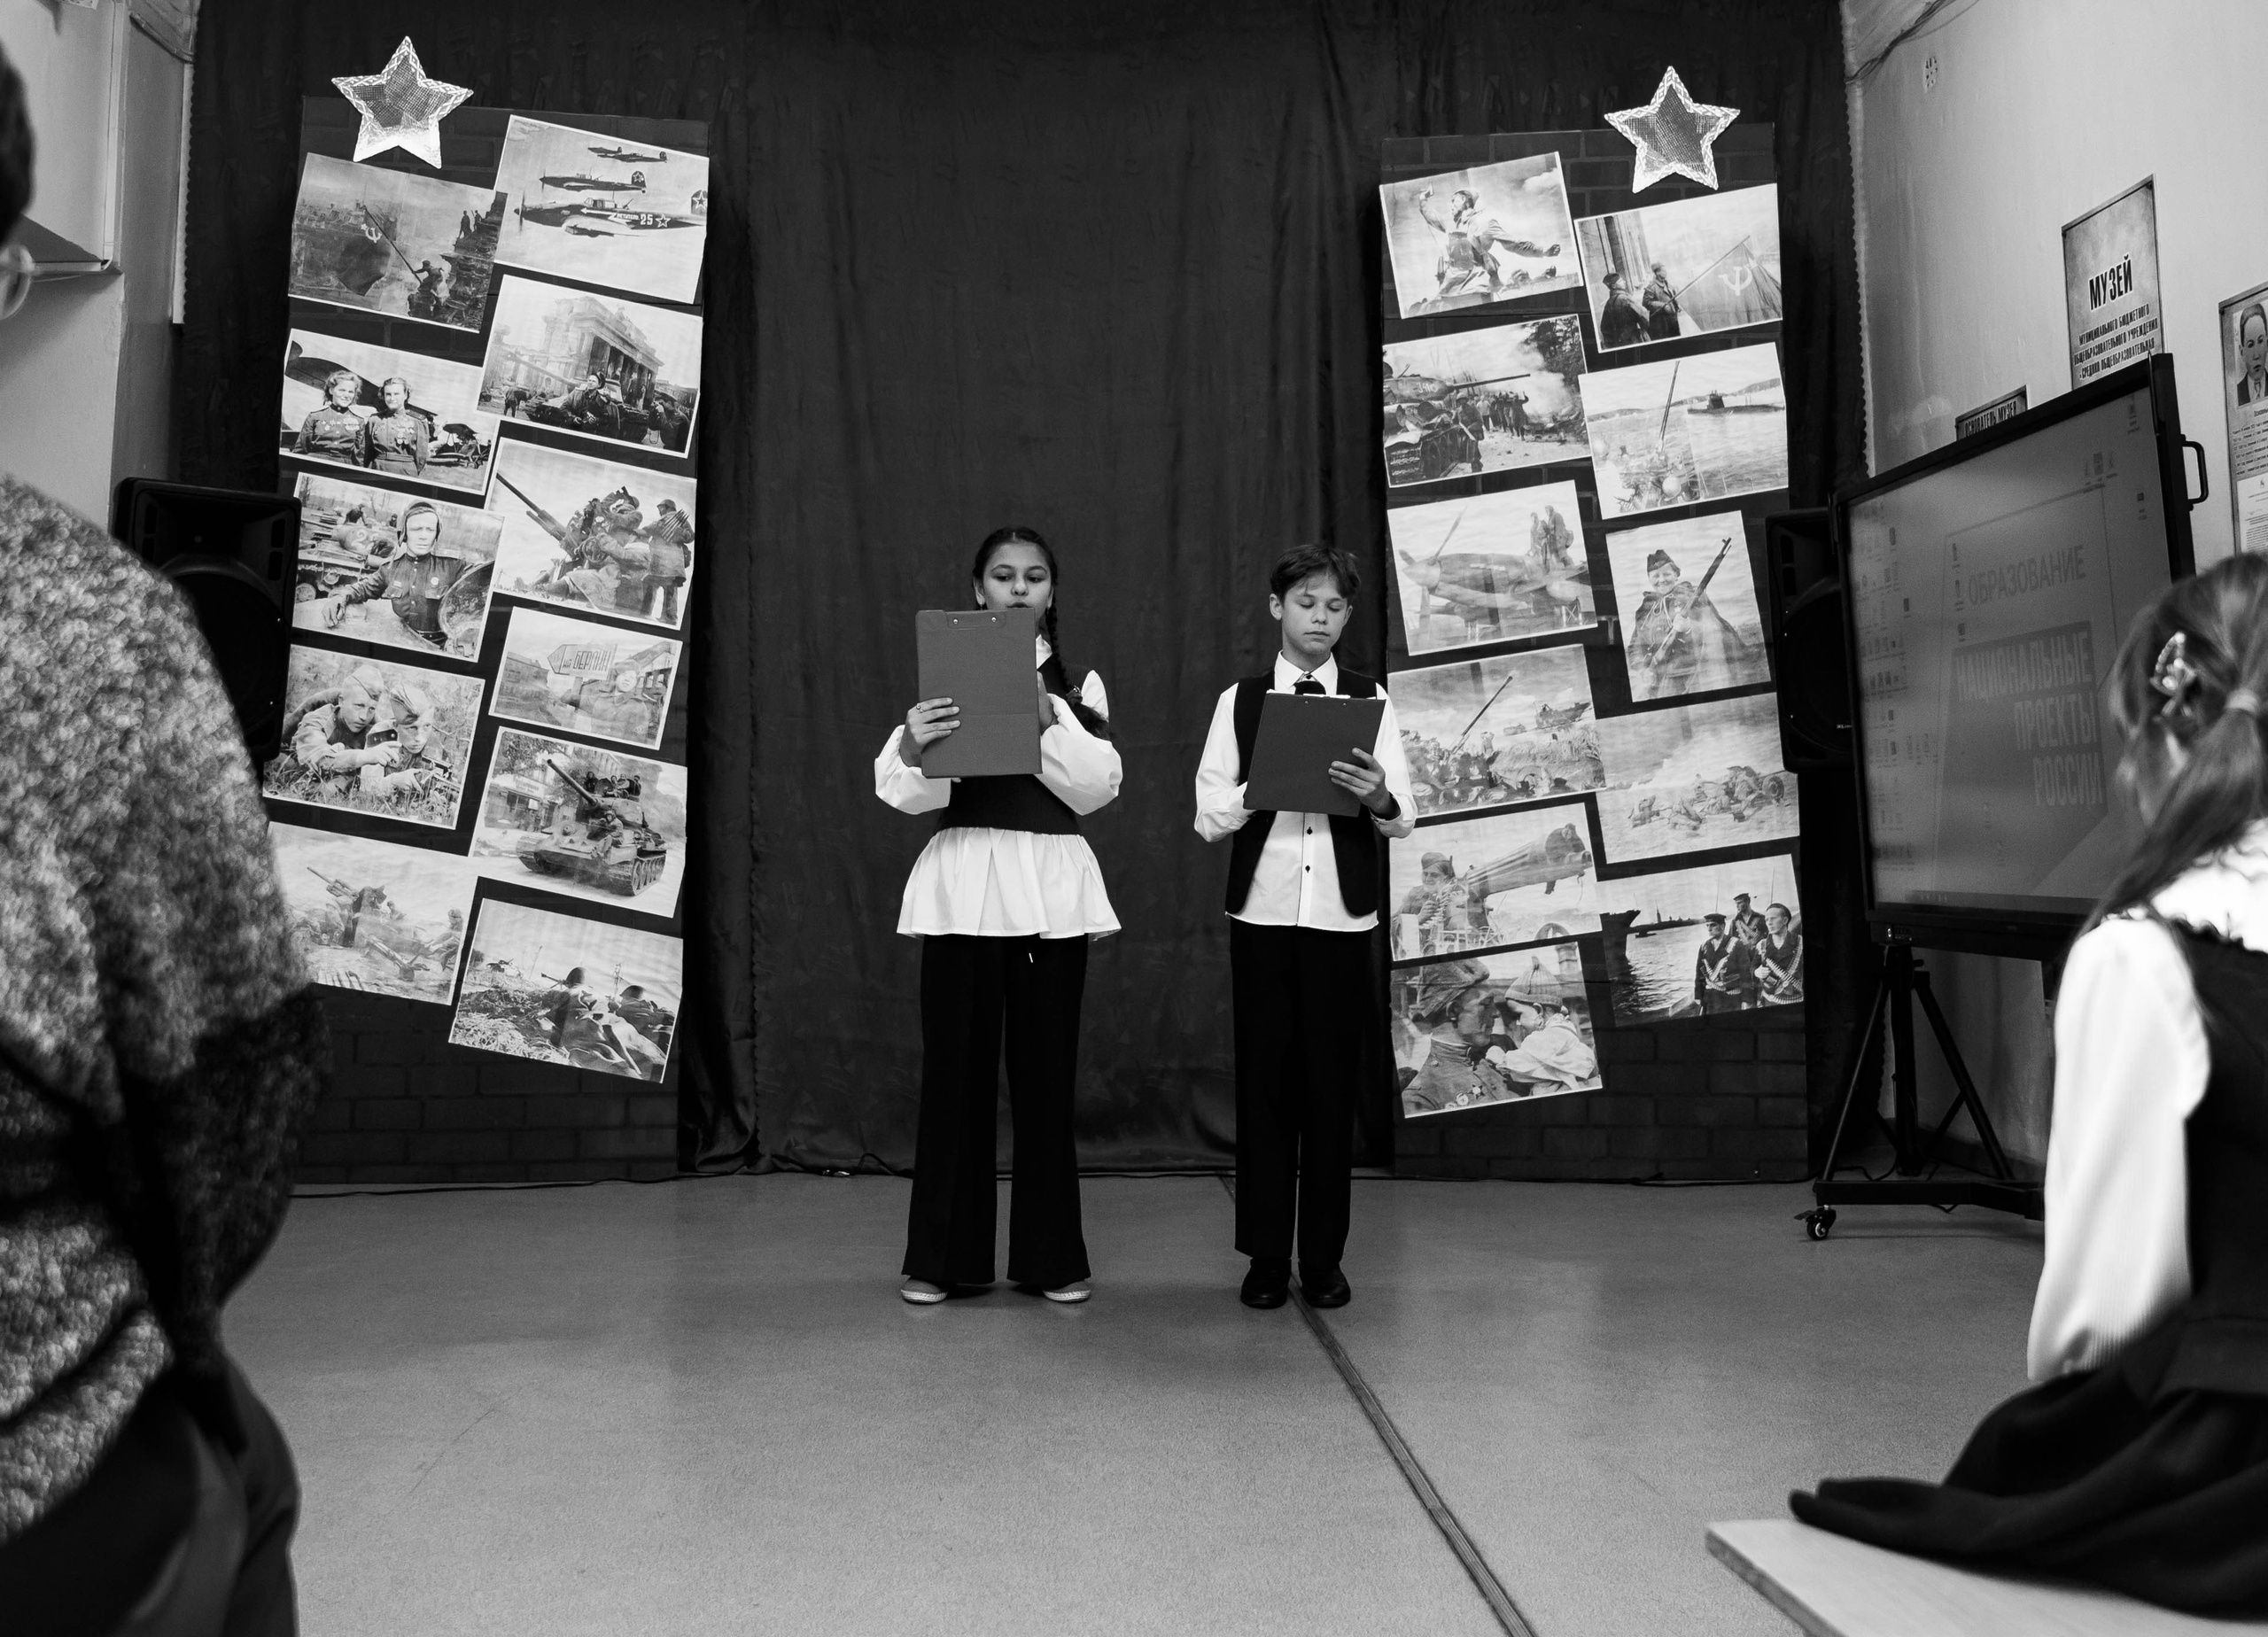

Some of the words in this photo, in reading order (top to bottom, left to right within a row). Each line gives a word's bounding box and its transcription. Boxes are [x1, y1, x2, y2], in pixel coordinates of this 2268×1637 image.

[640, 213, 654, 226] 25
[2089, 254, 2132, 311] МУЗЕЙ
[2118, 303, 2150, 328] БЮДЖЕТНОГО
[1969, 544, 2086, 606] ОБРАЗОВАНИЕ
[572, 650, 612, 671] БЕРЛИН
[1954, 630, 2093, 702] НАЦИОНАЛЬНЫЕ
[2014, 692, 2098, 750] ПРОЕКТЫ
[2033, 751, 2104, 807] РОССИИ
